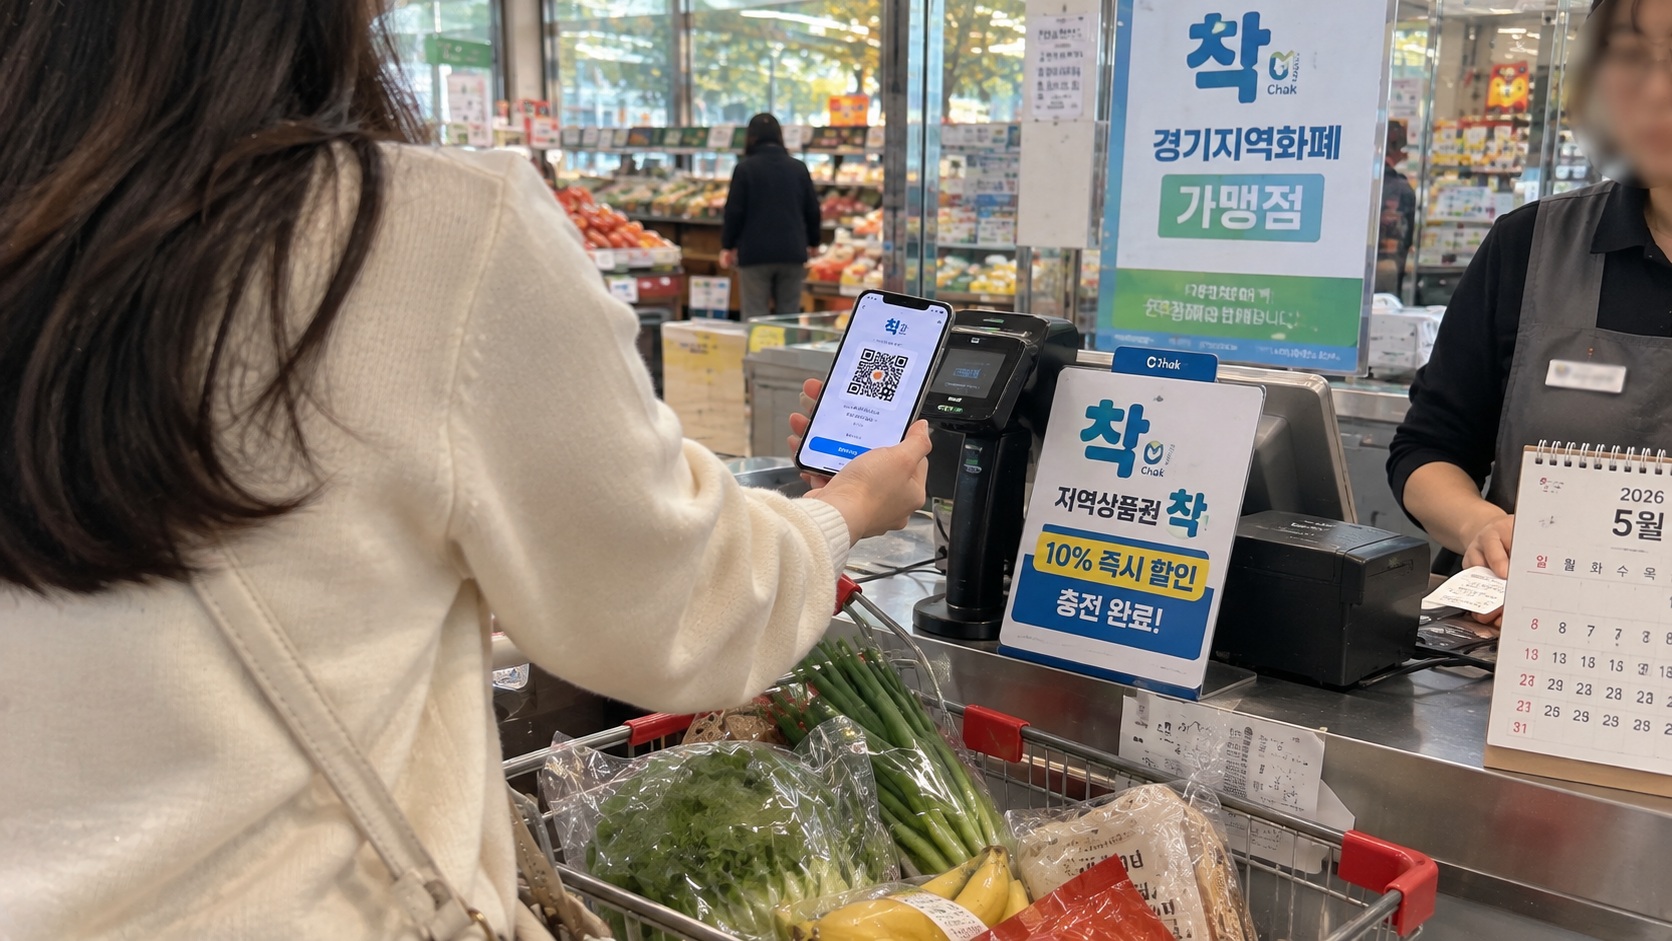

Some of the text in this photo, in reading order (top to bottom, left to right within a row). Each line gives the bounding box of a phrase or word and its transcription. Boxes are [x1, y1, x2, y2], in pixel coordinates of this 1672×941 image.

[1187, 11, 1271, 104] 착
[1267, 84, 1297, 95] Chak
[1153, 125, 1342, 162] 경기지역화폐
[1176, 184, 1303, 231] 가맹점
[1080, 399, 1150, 478] 착
[1141, 466, 1165, 478] Chak
[1054, 486, 1208, 538] 지역상품권 착
[1620, 487, 1664, 504] 2026
[1612, 508, 1664, 542] 5월
[1045, 541, 1198, 593] 10% 즉시 할인
[1590, 561, 1603, 575] 화
[1616, 565, 1629, 577] 수
[1056, 588, 1163, 634] 충전 완료!
[1530, 618, 1539, 630] 8
[1558, 621, 1567, 634] 8
[1587, 624, 1596, 637] 7
[1513, 721, 1527, 734] 31
